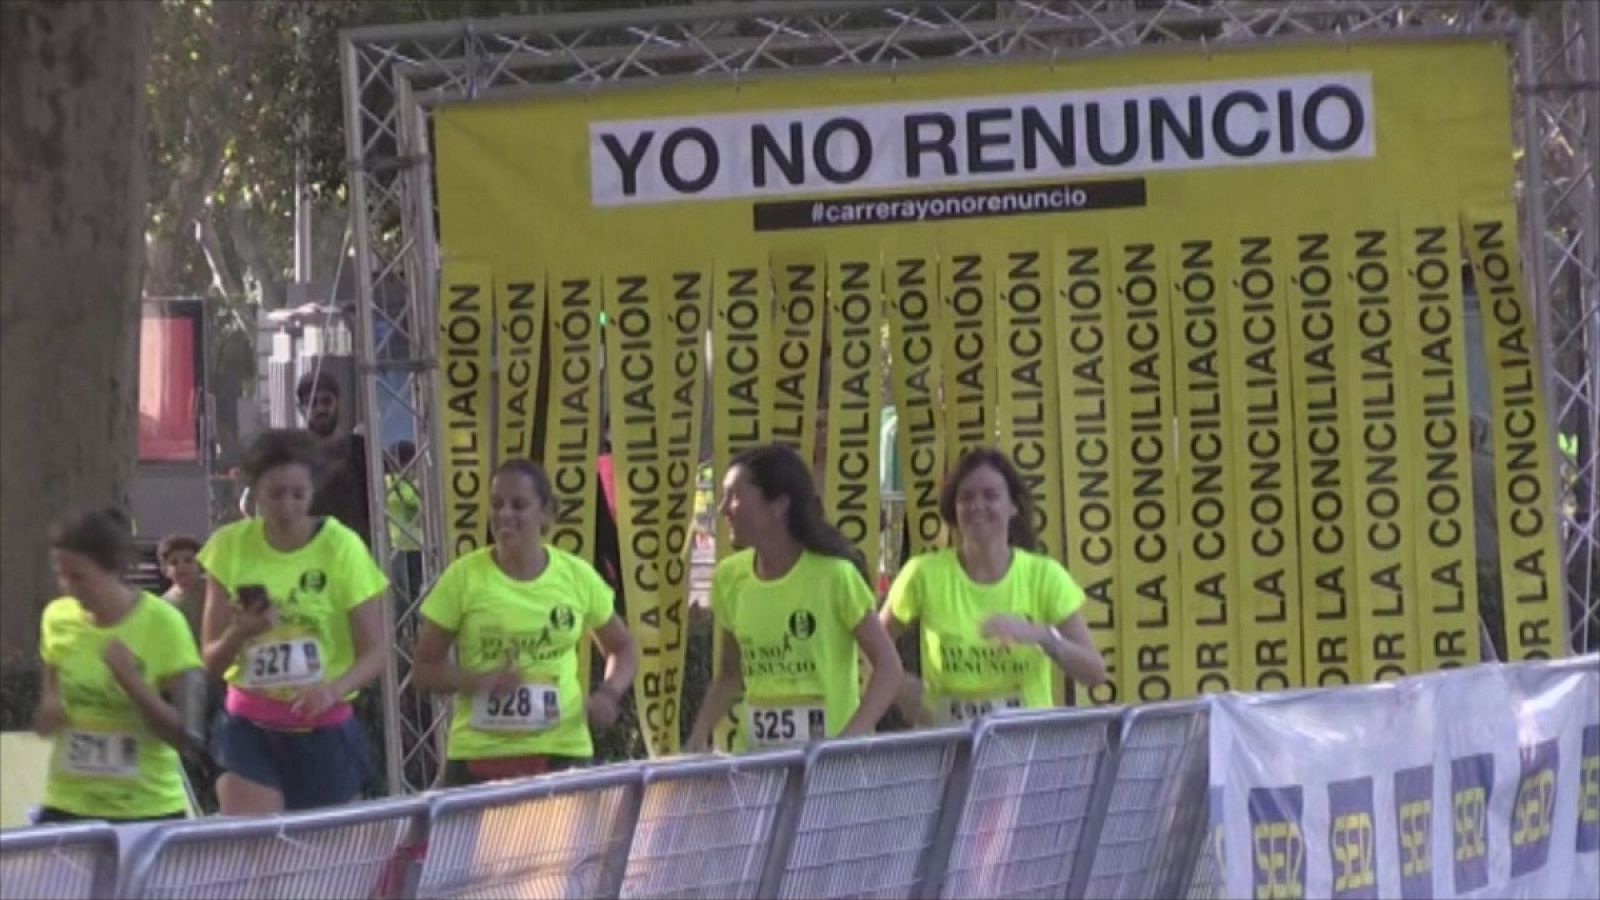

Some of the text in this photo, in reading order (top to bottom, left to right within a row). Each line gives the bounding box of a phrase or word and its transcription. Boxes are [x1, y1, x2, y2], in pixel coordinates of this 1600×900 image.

[600, 84, 1364, 196] YO NO RENUNCIO
[811, 185, 1087, 222] #carrerayonorenuncio
[440, 283, 480, 556] ONCILIACIÓN
[502, 283, 535, 455] LIACIÓN
[552, 280, 592, 554] ONCILIACIÓN
[610, 275, 660, 591] CONCILIACIÓN
[665, 272, 702, 586] CONCILIACIÓN
[718, 268, 760, 442] LIACIÓN
[770, 264, 815, 438] LIACIÓN
[833, 262, 872, 544] ONCILIACIÓN
[891, 258, 941, 545] ONCILIACIÓN
[944, 254, 985, 444] ILIACIÓN
[1060, 247, 1113, 565] CONCILIACIÓN
[1118, 243, 1171, 701] OR LA CONCILIACIÓN
[1175, 239, 1229, 693] OR LA CONCILIACIÓN
[1233, 236, 1289, 691] OR LA CONCILIACIÓN
[1290, 233, 1349, 685] OR LA CONCILIACIÓN
[1347, 230, 1406, 680] OR LA CONCILIACIÓN
[1407, 227, 1462, 548] CONCILIACIÓN
[1472, 220, 1543, 538] CONCILIACIÓN
[665, 599, 682, 650] LA
[1085, 577, 1114, 629] LA
[1430, 559, 1464, 613] LA
[1513, 548, 1548, 604] LA
[753, 708, 796, 739] 525
